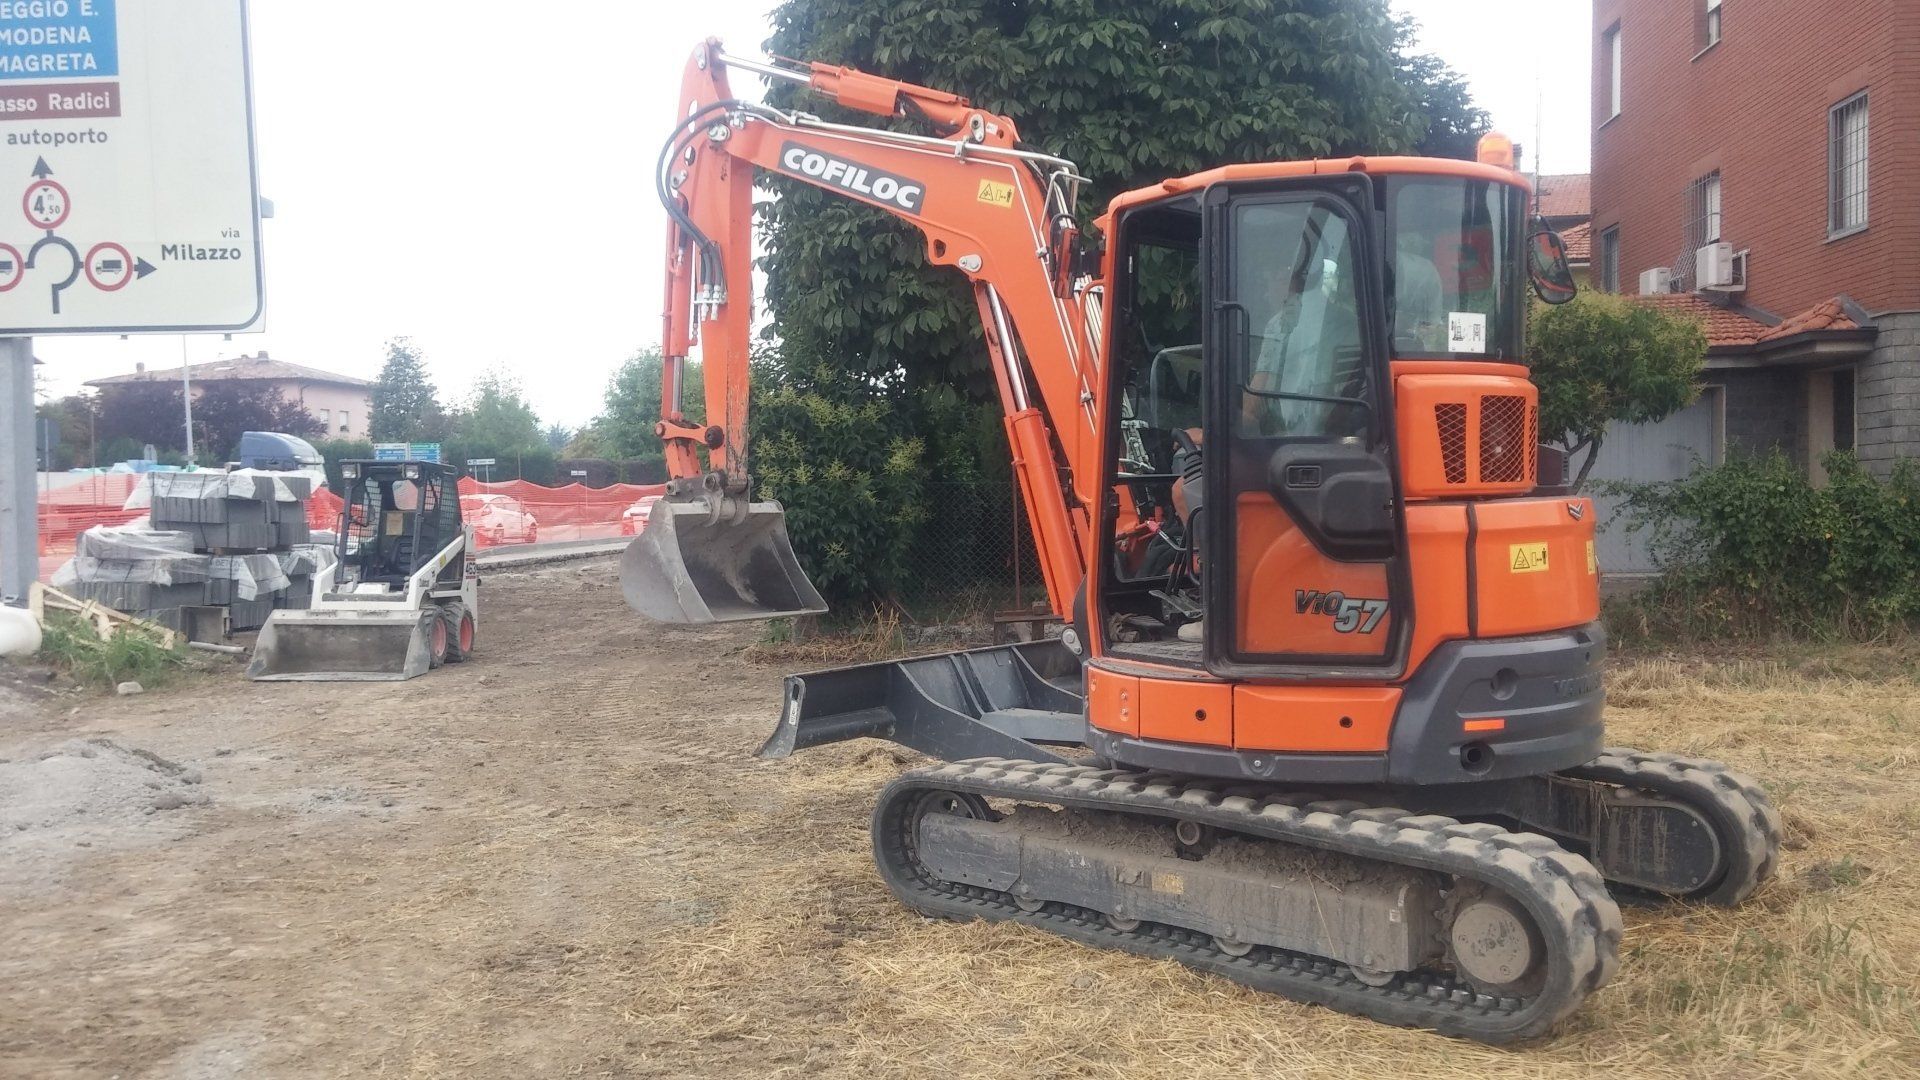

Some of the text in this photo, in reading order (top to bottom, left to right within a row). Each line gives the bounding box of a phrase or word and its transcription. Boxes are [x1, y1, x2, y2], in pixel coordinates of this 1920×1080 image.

[80, 0, 99, 16] E.
[0, 26, 92, 45] MODENA
[48, 92, 110, 110] Radici
[7, 128, 108, 147] autoporto
[784, 148, 920, 208] COFILOC
[34, 195, 45, 214] 4
[221, 227, 240, 238] via
[161, 243, 241, 260] Milazzo
